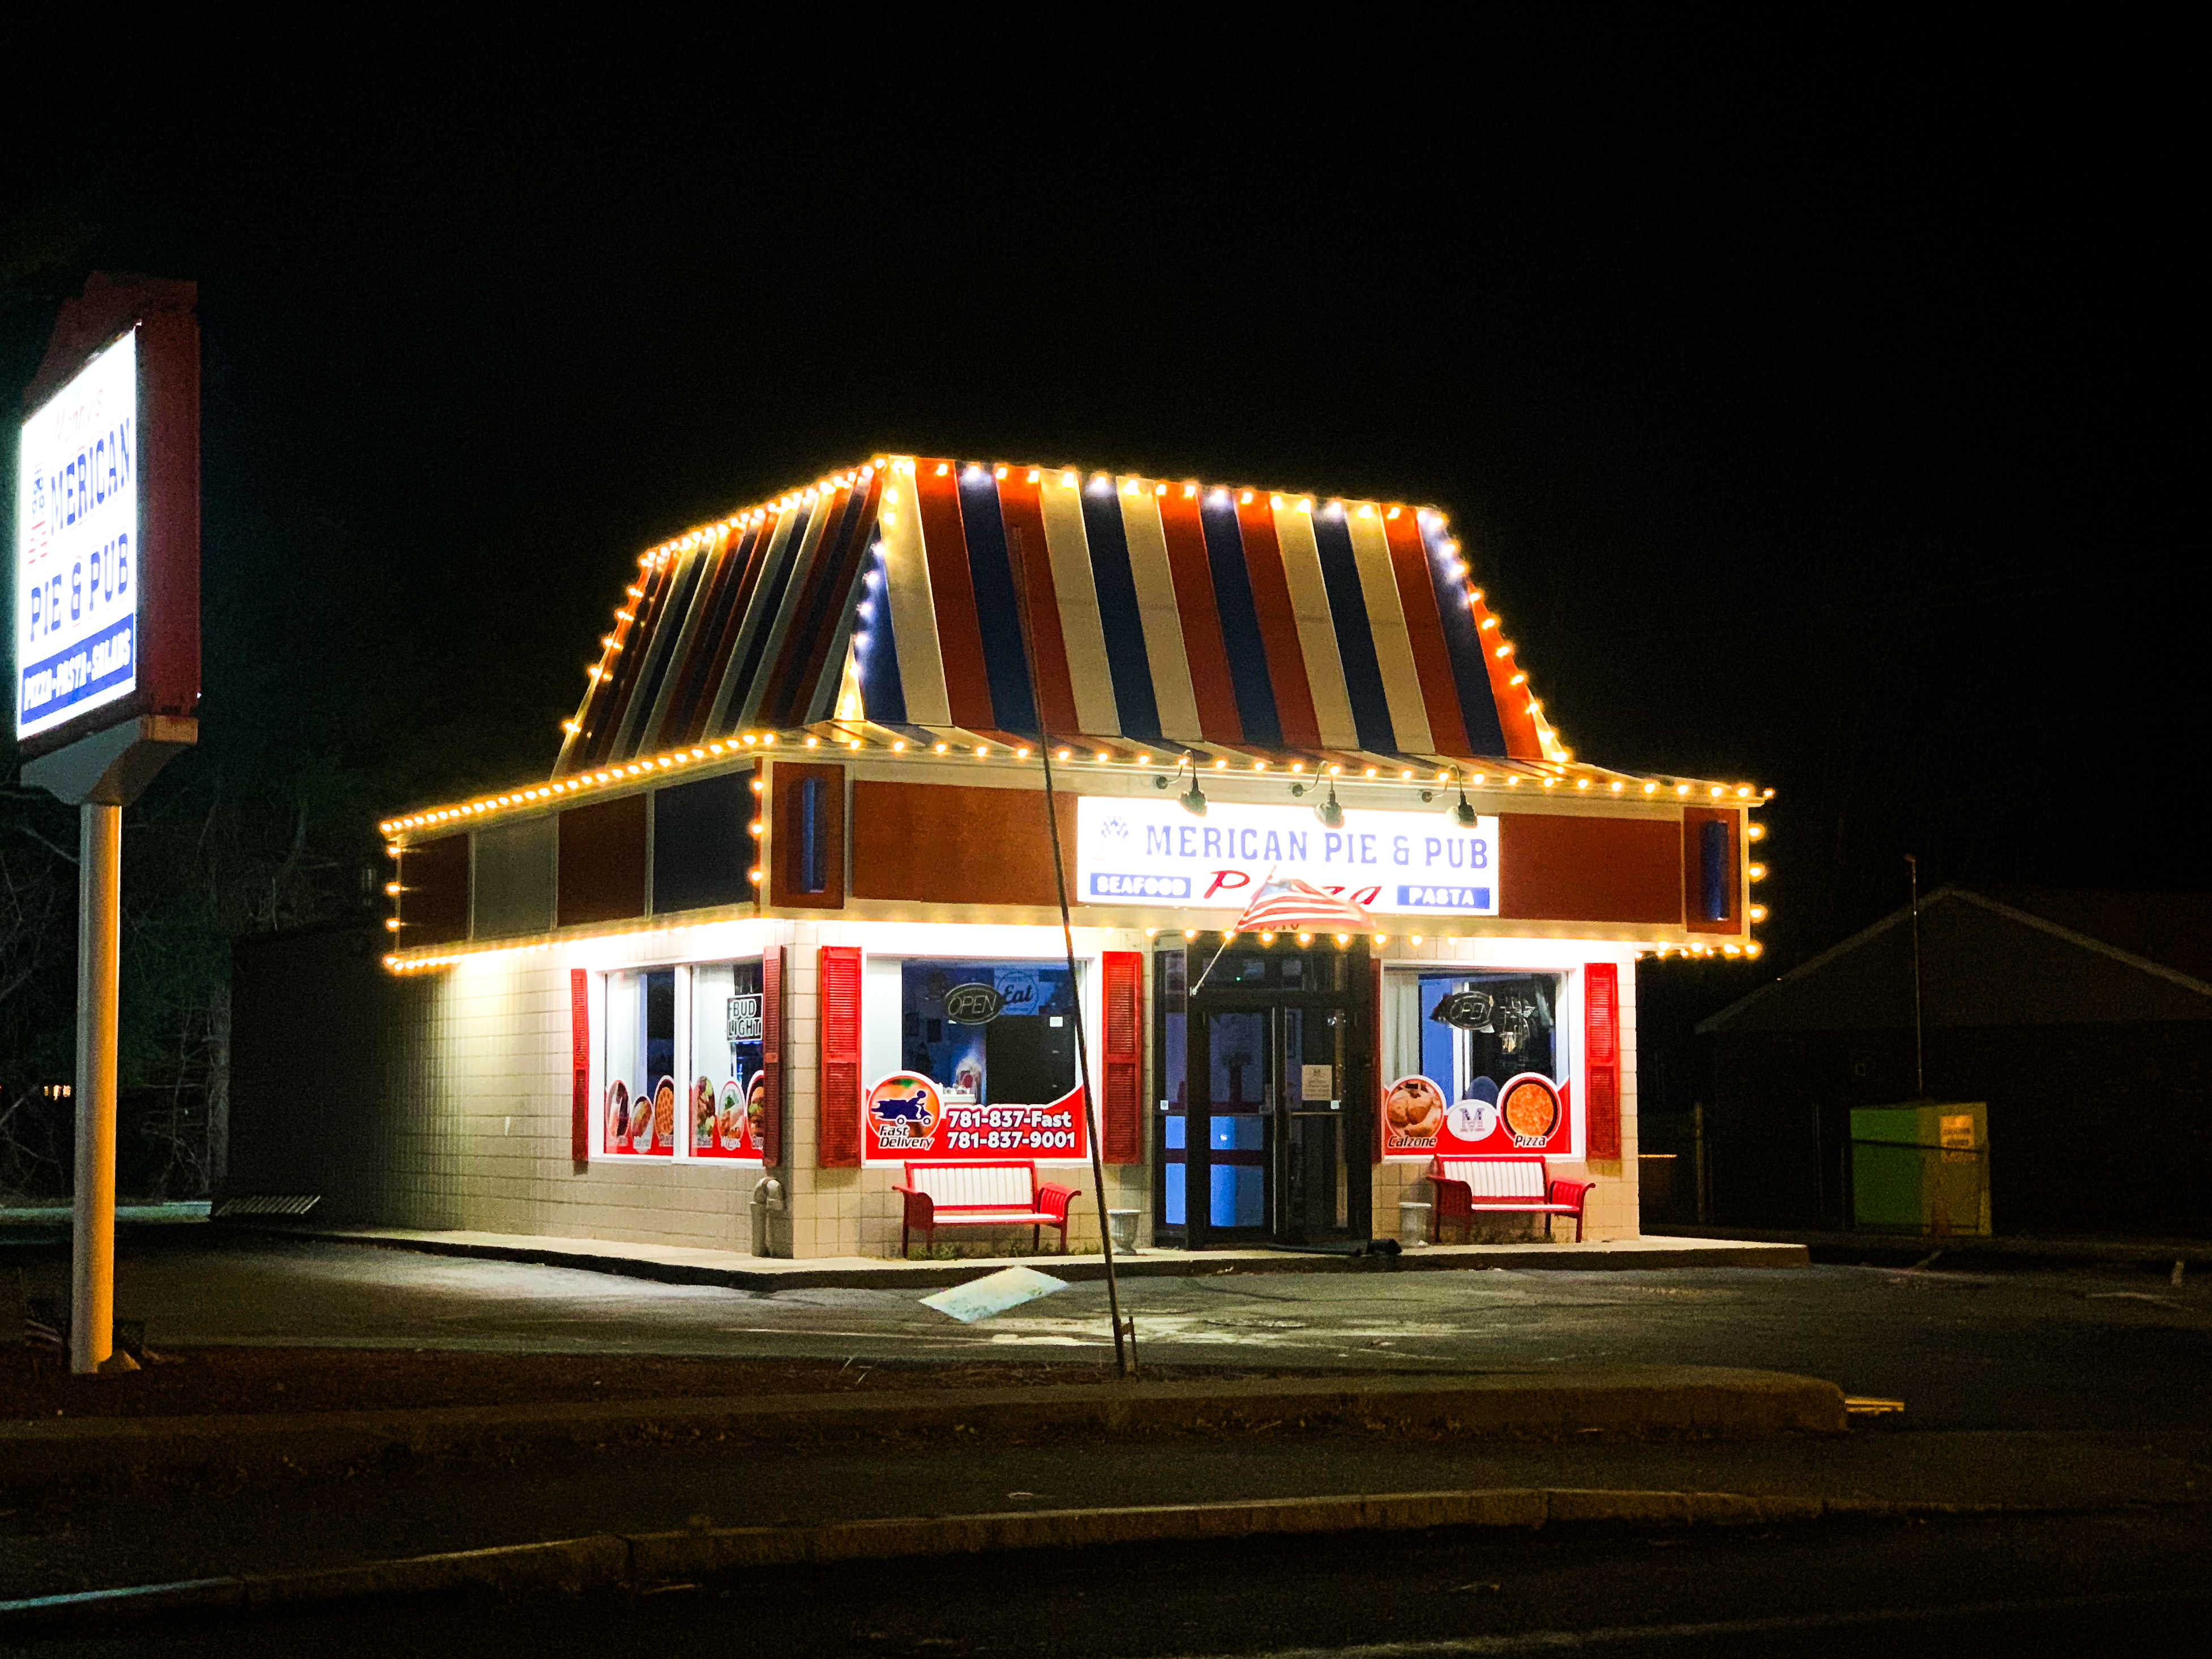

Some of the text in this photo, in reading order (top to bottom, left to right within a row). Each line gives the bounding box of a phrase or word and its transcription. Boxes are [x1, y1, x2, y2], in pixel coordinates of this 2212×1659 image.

[30, 533, 129, 642] PIE & PUB
[1324, 832, 1377, 865] PIE
[1393, 835, 1410, 866] &
[1424, 837, 1488, 870] PUB
[1096, 875, 1187, 896] SEAFOOD
[1408, 887, 1475, 905] PASTA
[1004, 985, 1033, 1004] Eat
[733, 1000, 756, 1017] BUD
[948, 994, 998, 1016] OPEN
[729, 1019, 760, 1036] LIGHT
[948, 1110, 1072, 1128] 781-837-Fast
[879, 1125, 910, 1137] Fast
[879, 1136, 935, 1149] Delivery
[947, 1132, 1075, 1149] 781-837-9001
[1388, 1136, 1437, 1147] Calzone
[1515, 1135, 1546, 1147] Pizza
